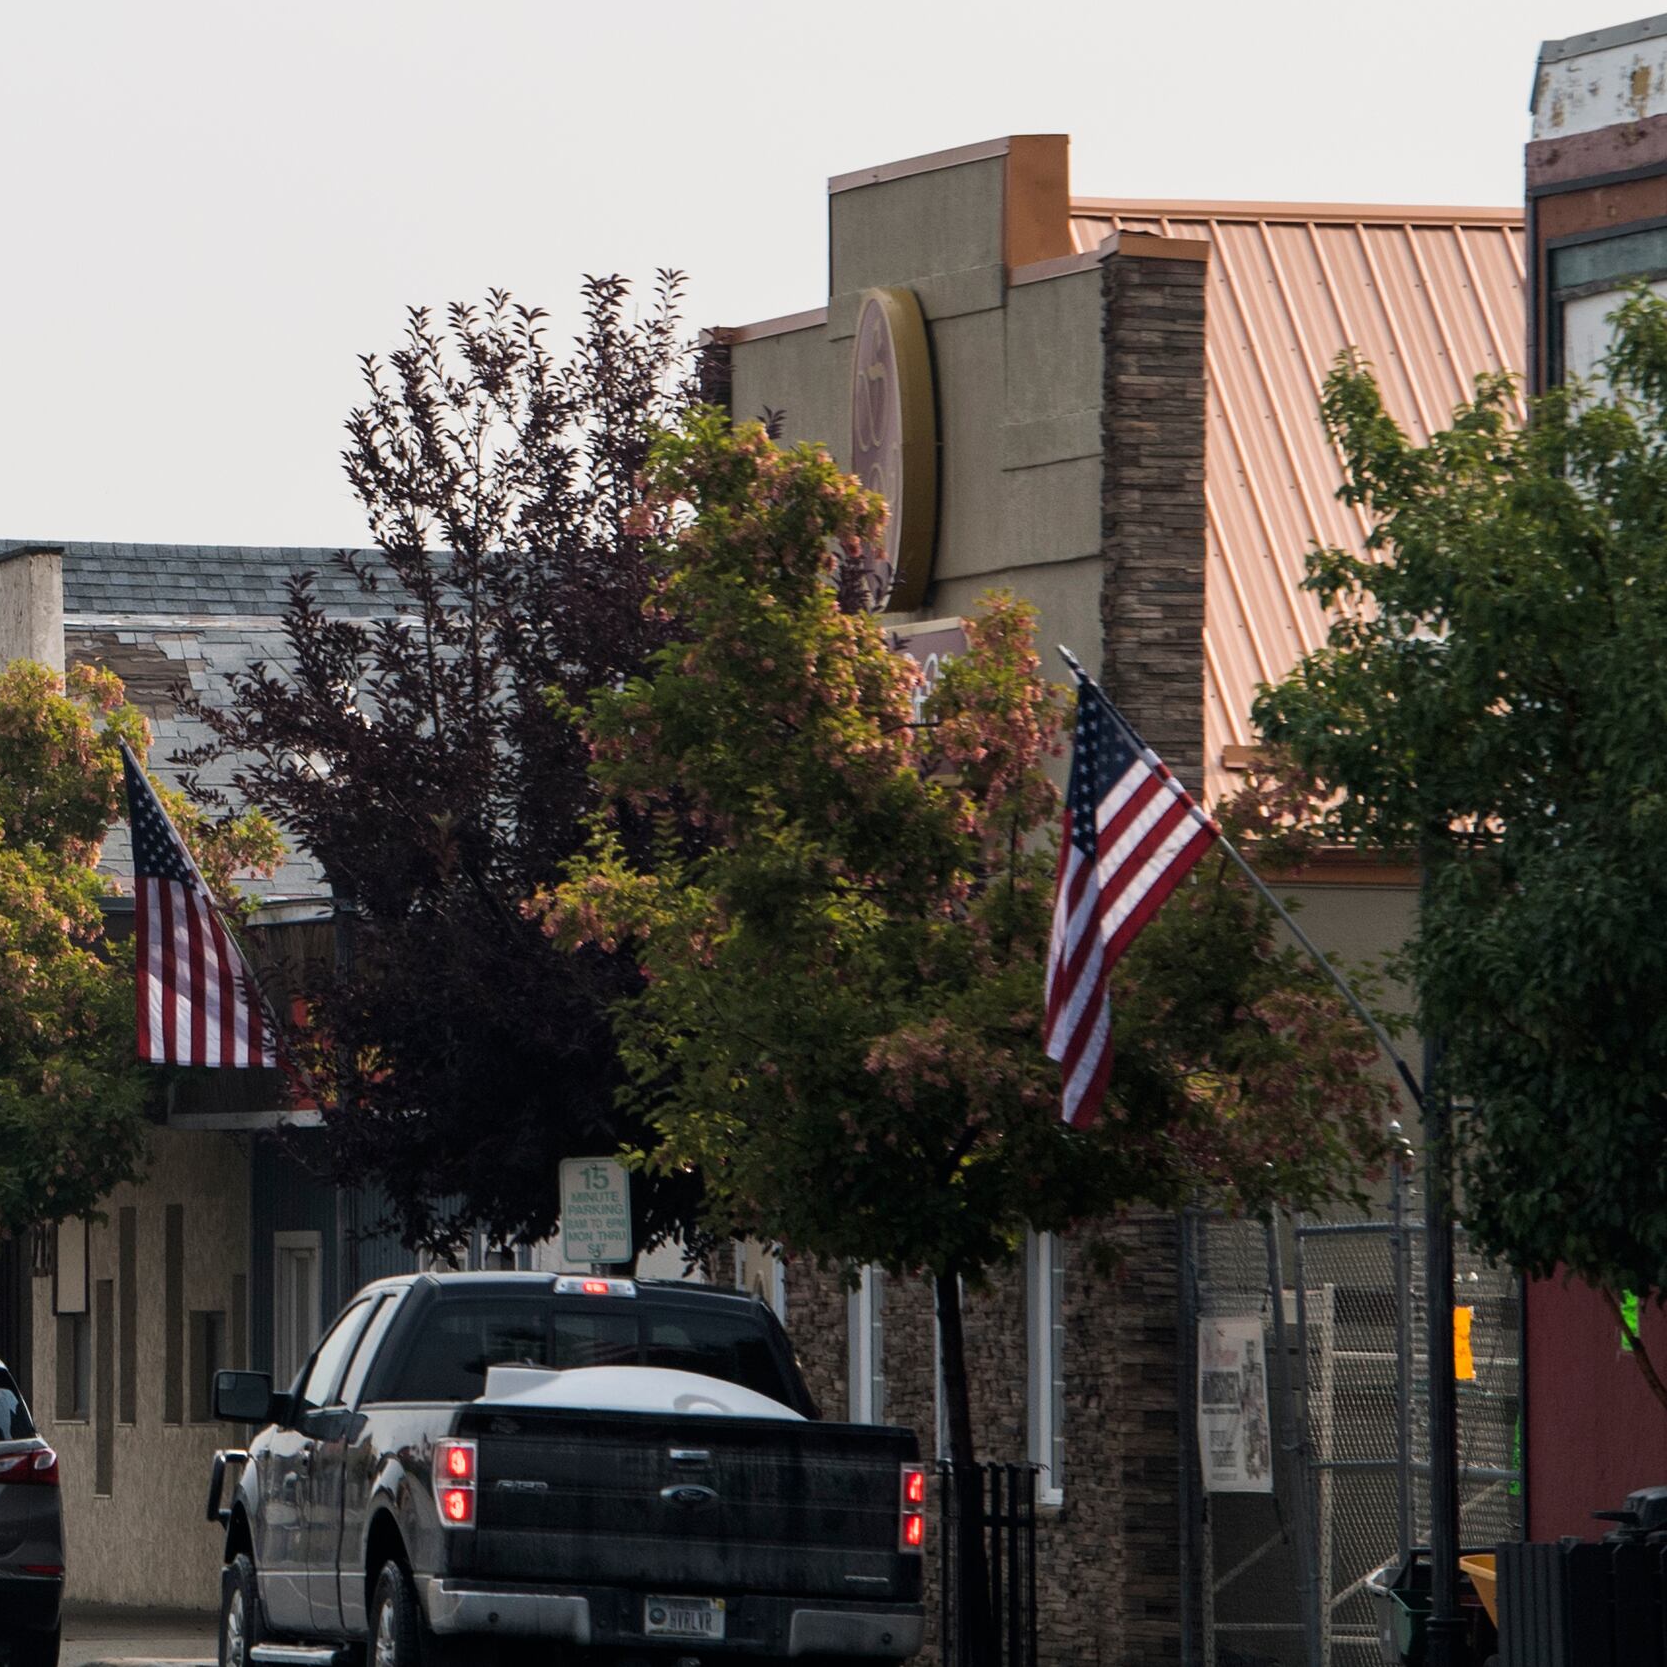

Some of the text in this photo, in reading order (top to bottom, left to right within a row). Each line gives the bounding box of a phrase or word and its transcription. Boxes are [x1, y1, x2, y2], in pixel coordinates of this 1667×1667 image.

[579, 1166, 610, 1190] 15
[570, 1192, 620, 1203] MINUTE
[568, 1204, 624, 1215] PARKING
[590, 1218, 603, 1229] TO
[567, 1230, 626, 1242] MON THRU
